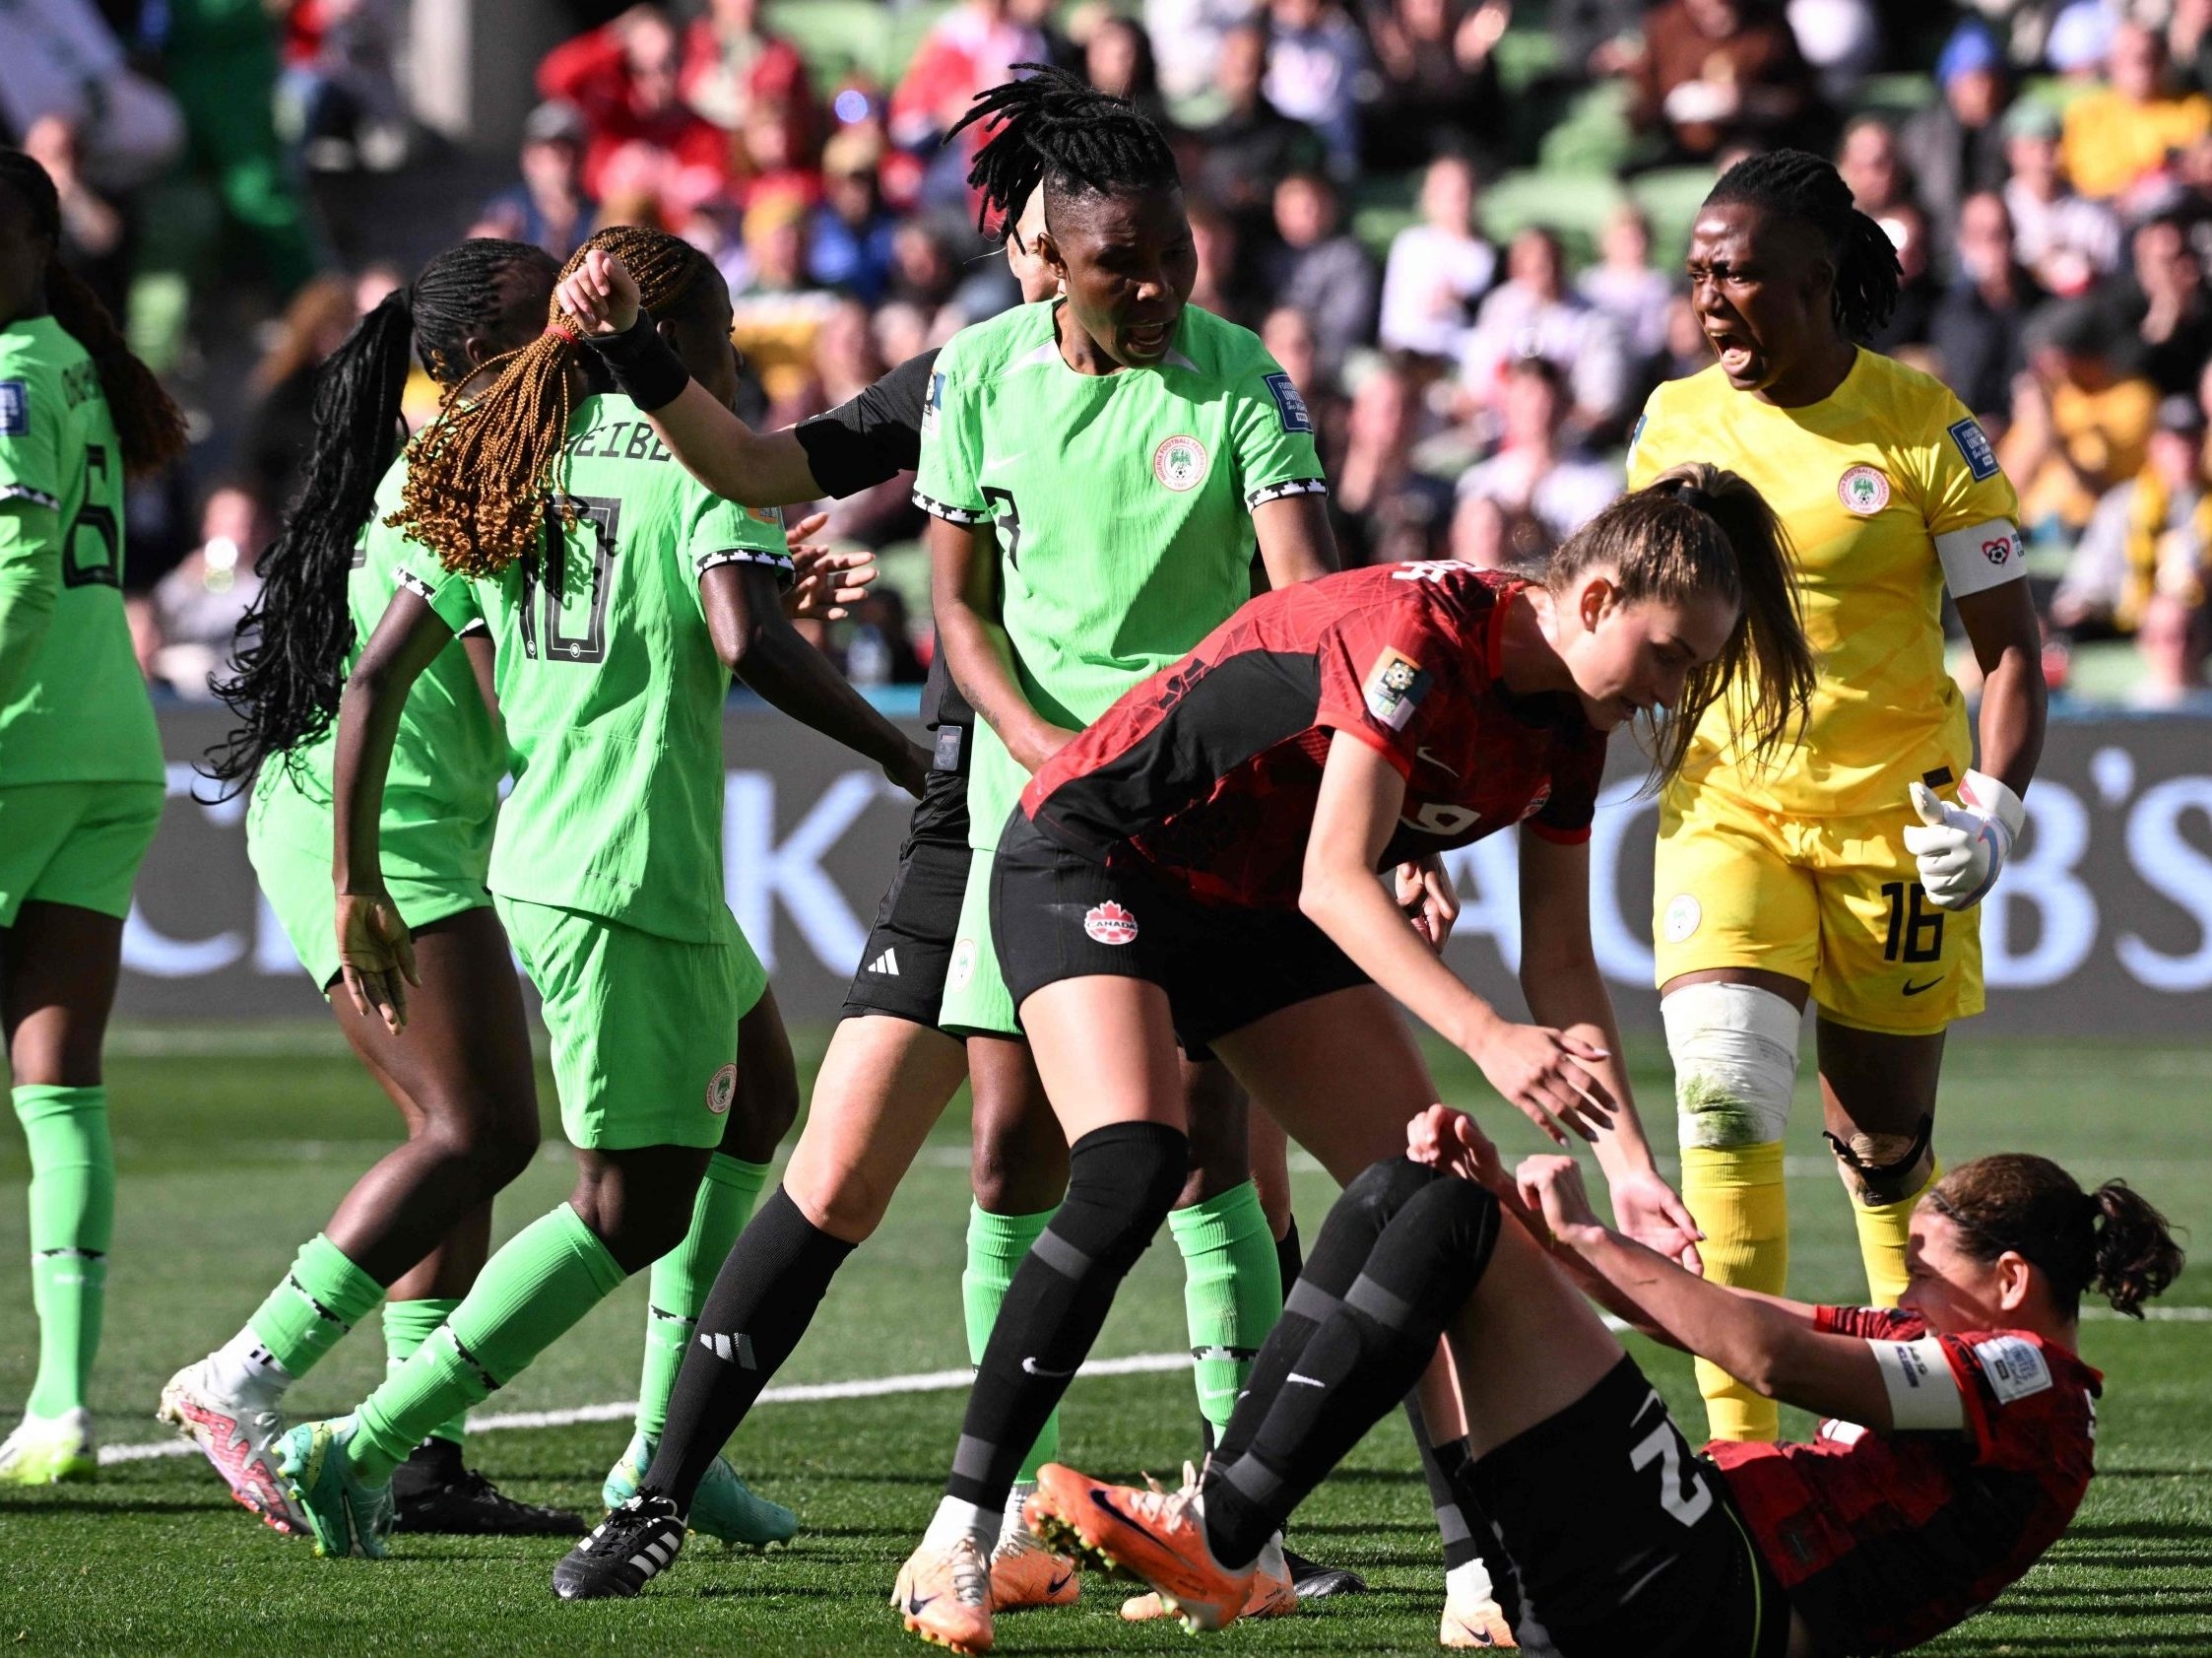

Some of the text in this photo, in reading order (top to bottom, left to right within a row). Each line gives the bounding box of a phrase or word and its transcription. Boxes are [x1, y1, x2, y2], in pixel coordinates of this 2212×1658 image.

[1160, 437, 1191, 455] FOOTBALL
[62, 444, 123, 589] 6
[519, 494, 622, 665] 10
[1881, 882, 1945, 962] 16
[1629, 1420, 1713, 1528] 2
